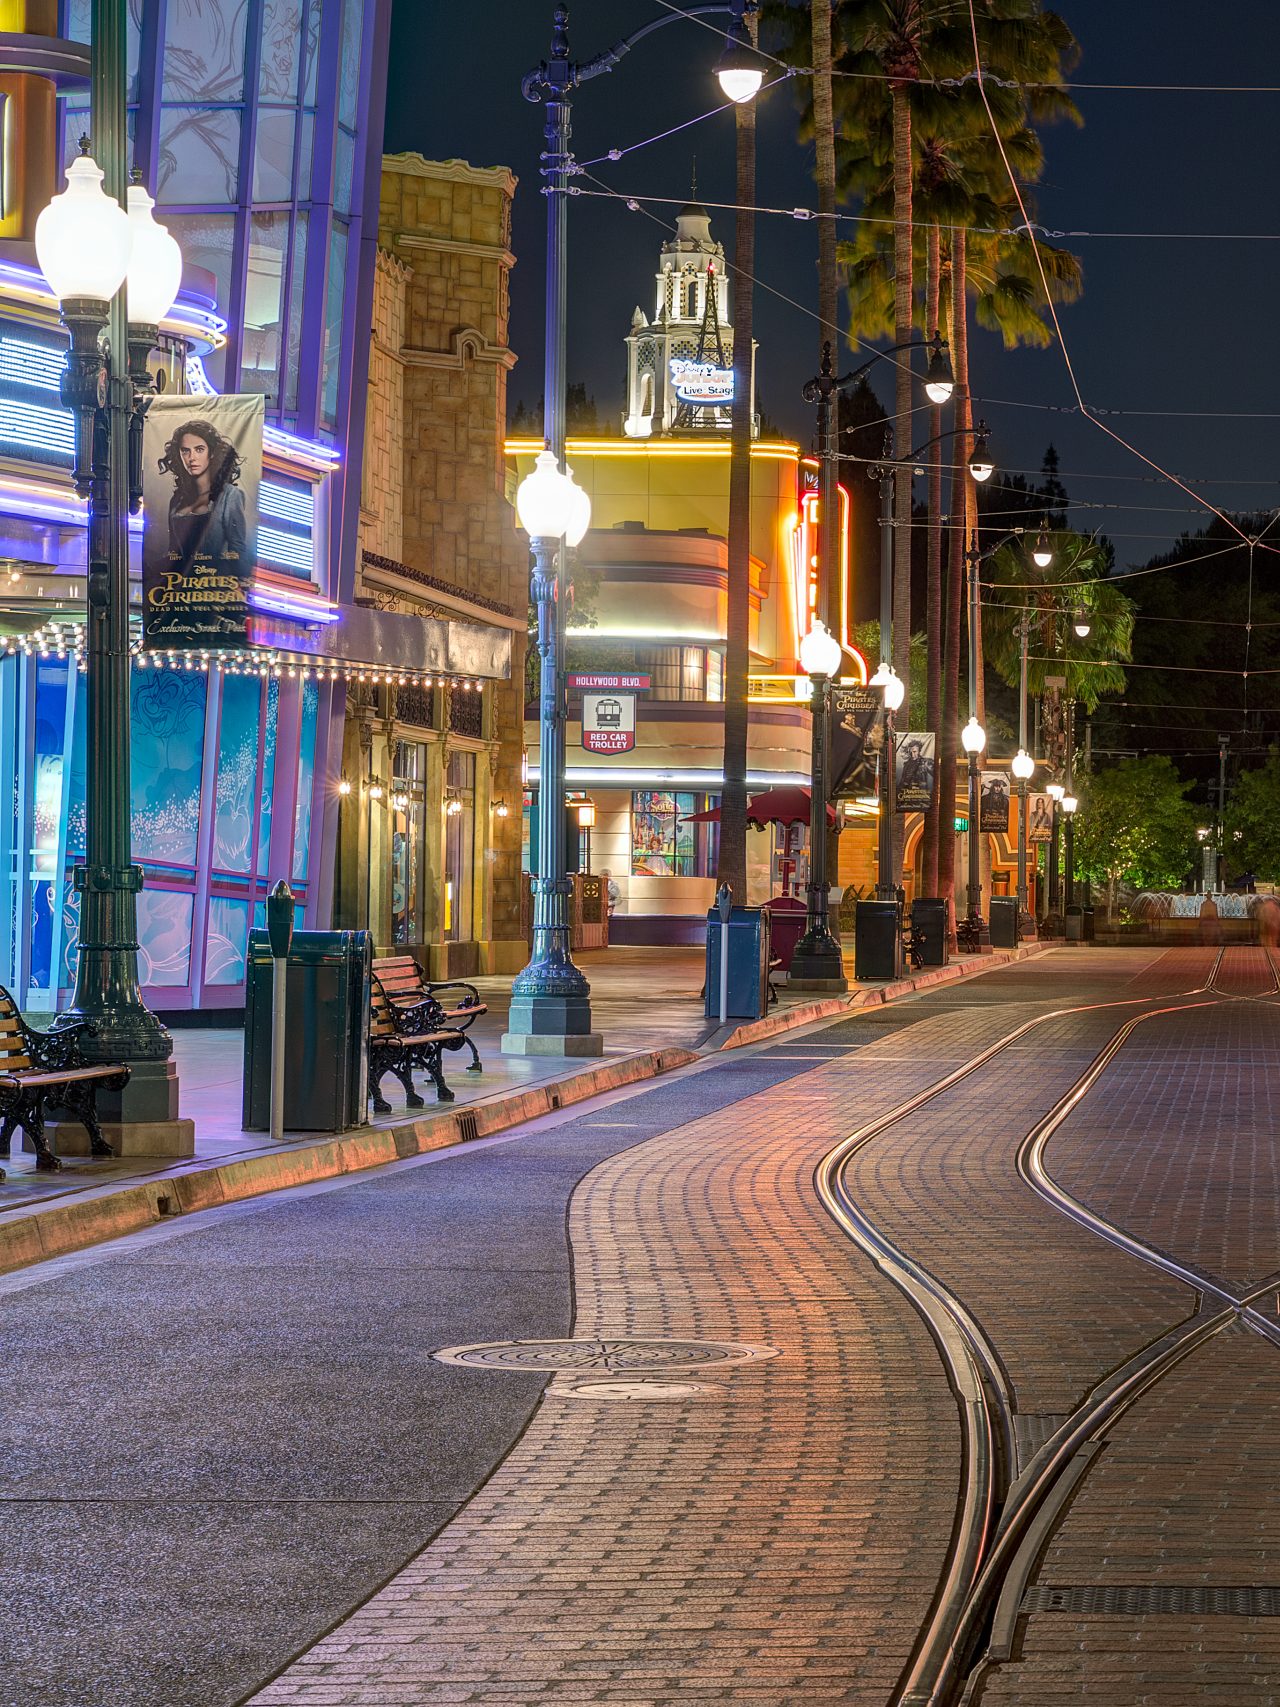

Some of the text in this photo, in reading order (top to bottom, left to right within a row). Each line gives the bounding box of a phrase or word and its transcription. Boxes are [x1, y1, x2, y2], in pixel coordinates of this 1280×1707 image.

[684, 386, 703, 395] Live
[193, 565, 218, 575] Disney
[160, 572, 239, 591] PIRATES
[148, 586, 249, 606] CARIBBEAN
[146, 617, 192, 635] Exclusive
[575, 676, 641, 687] HOLLYWOOD BLVD.
[590, 733, 627, 741] RED CAR
[589, 741, 628, 749] TROLLEY
